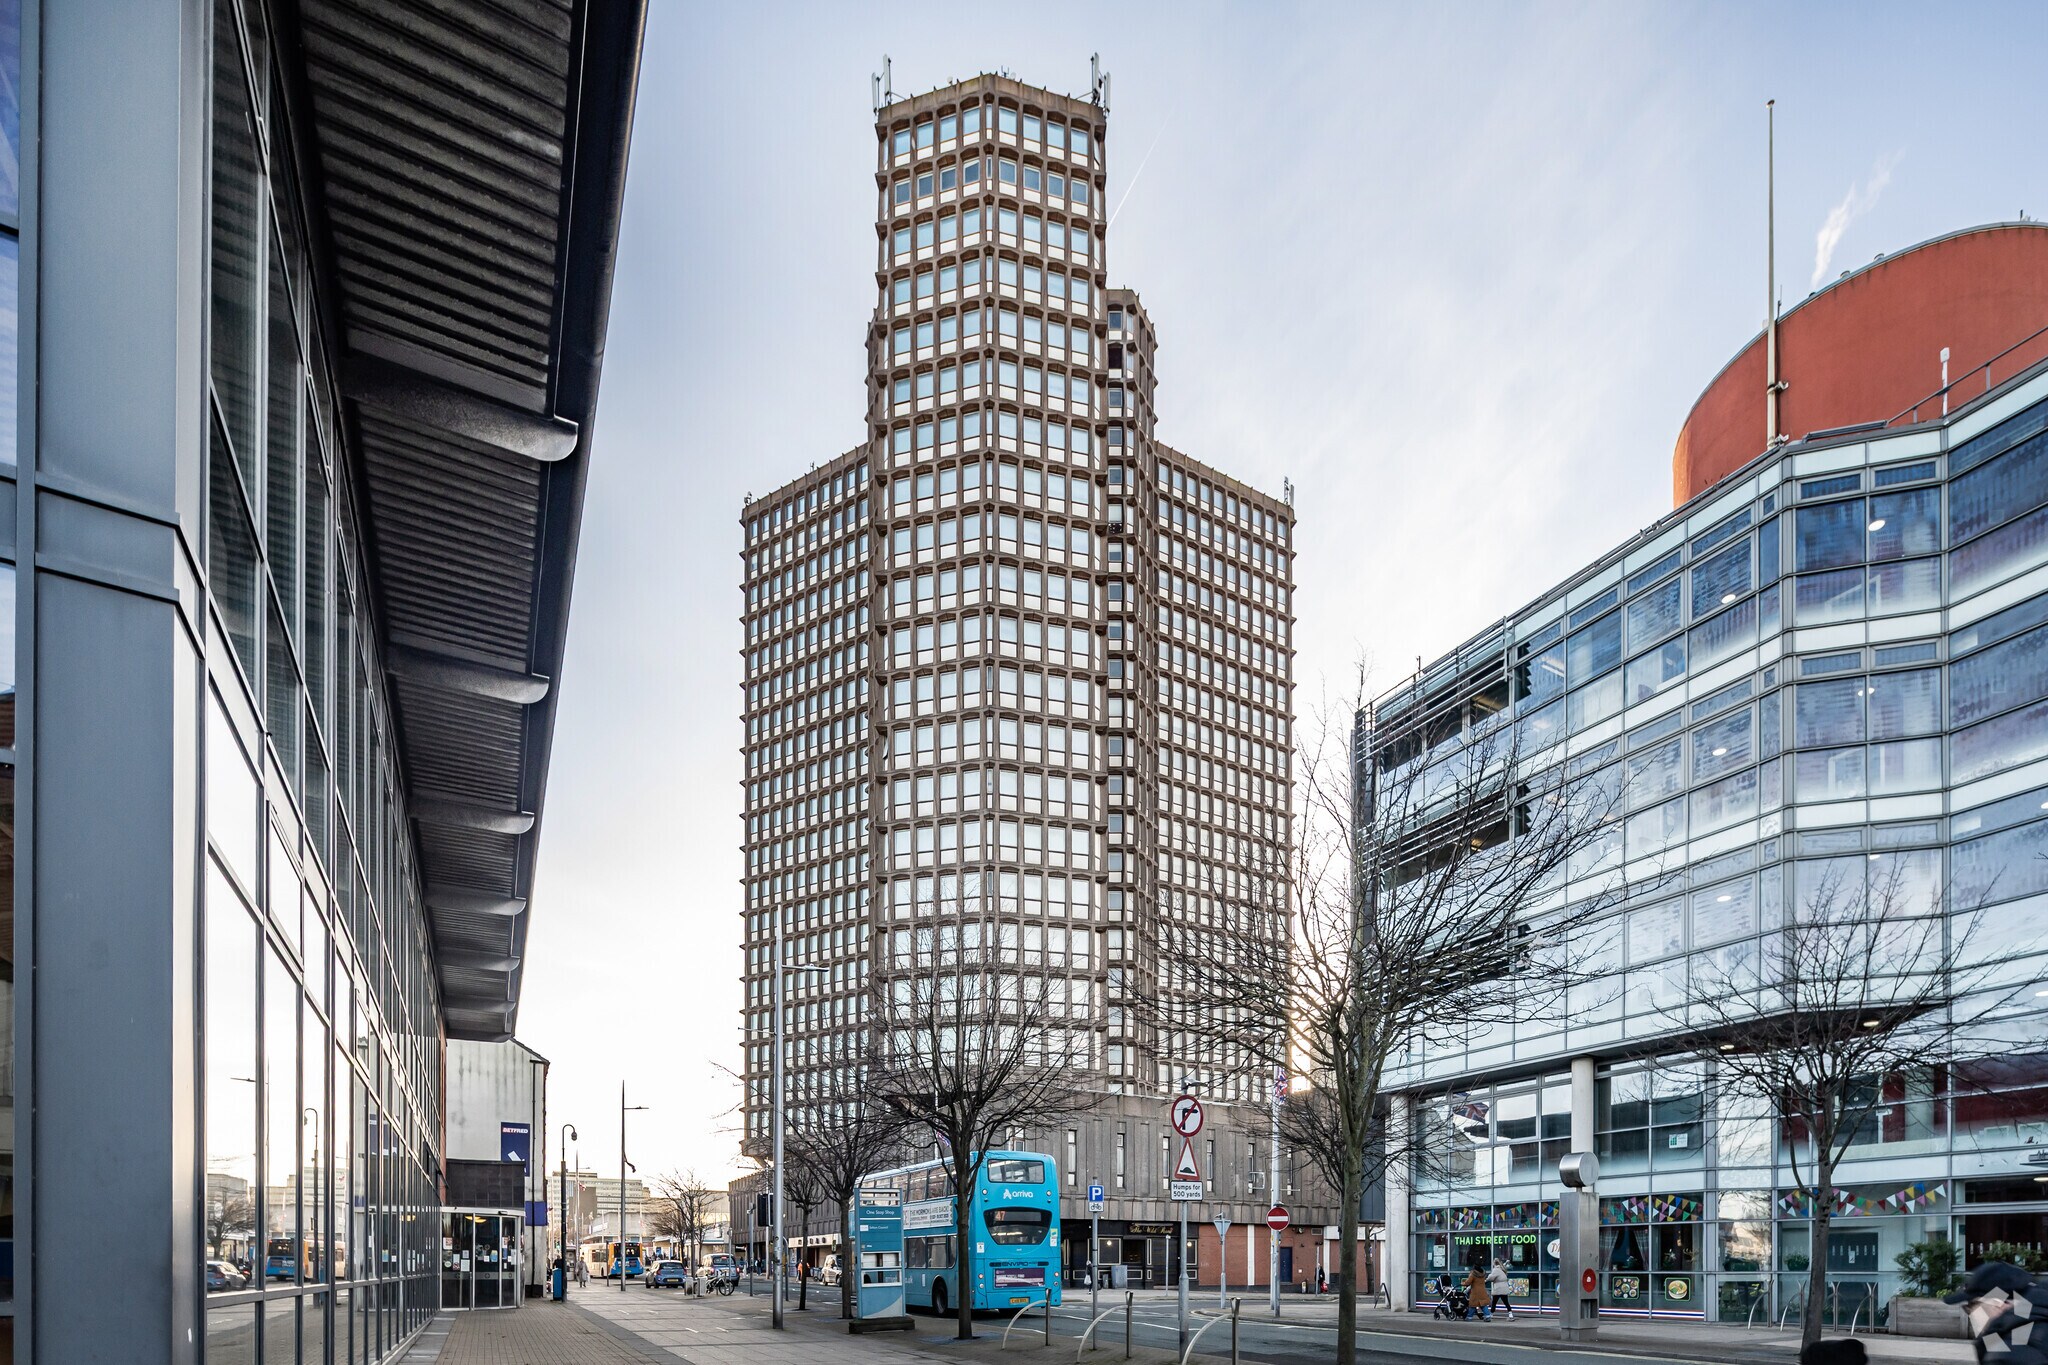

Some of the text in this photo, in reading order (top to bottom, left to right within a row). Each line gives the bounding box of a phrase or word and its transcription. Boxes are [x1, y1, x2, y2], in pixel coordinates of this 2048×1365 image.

[1012, 1190, 1034, 1198] arriva
[1092, 1187, 1102, 1201] P
[995, 1210, 1006, 1221] 47
[1455, 1235, 1537, 1245] THAI STREET FOOD
